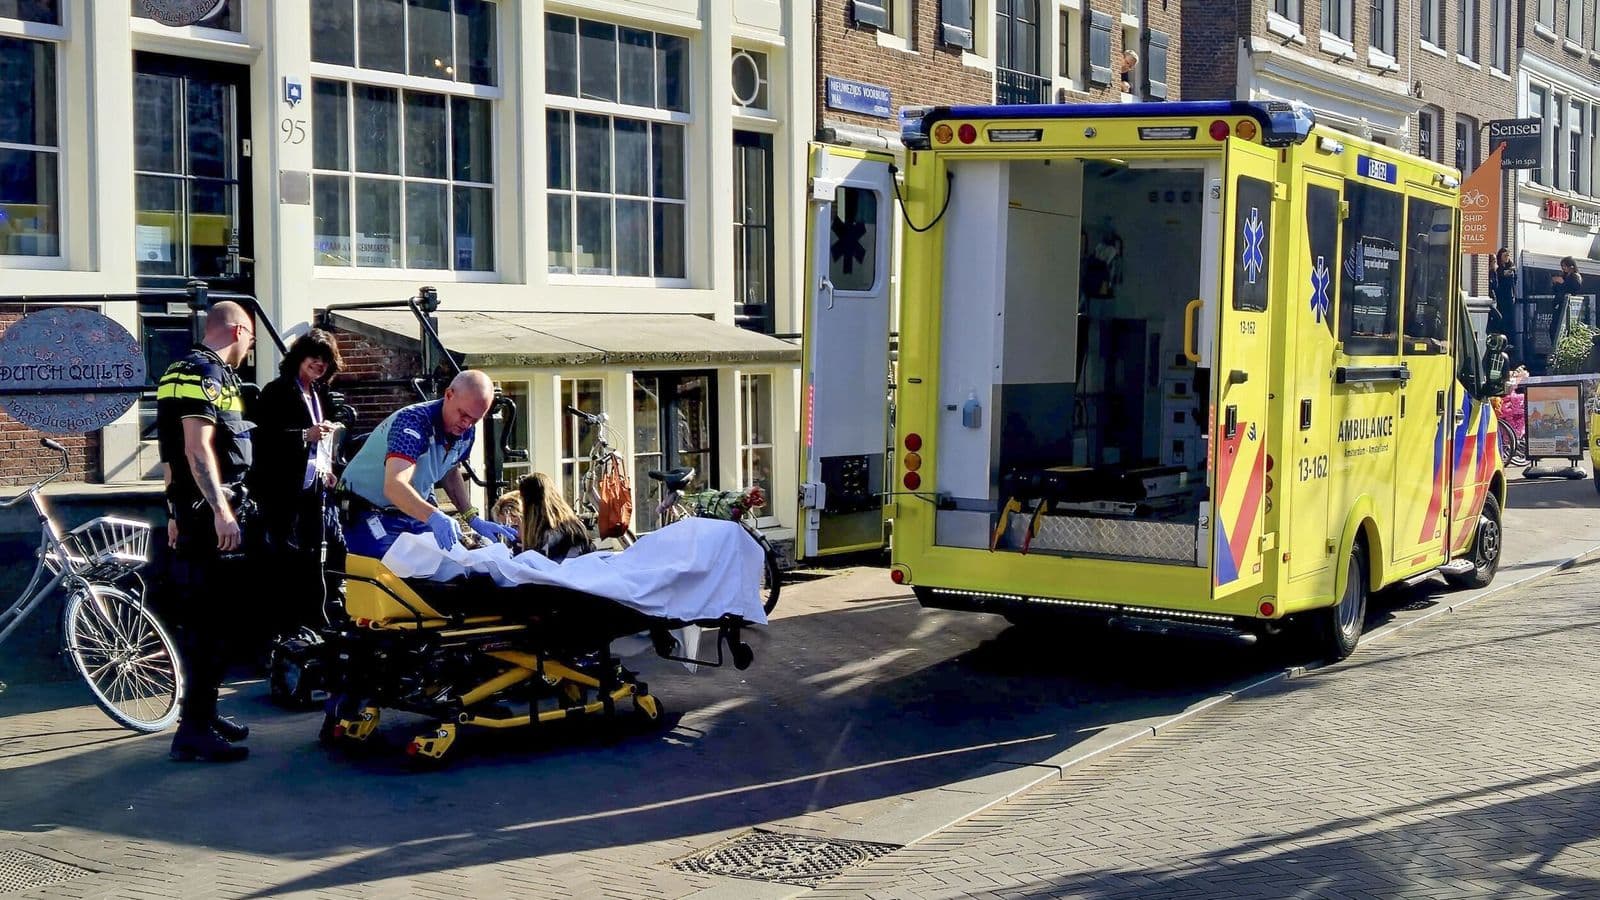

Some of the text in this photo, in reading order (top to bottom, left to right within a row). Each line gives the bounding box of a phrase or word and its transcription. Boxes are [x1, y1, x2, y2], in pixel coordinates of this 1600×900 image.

[281, 118, 306, 144] 95
[1491, 122, 1530, 136] Sense
[1369, 160, 1386, 179] 13-162
[1524, 158, 1536, 167] spa
[1240, 320, 1256, 335] 13-162
[0, 363, 134, 381] DUTCH QUILTS
[7, 399, 92, 430] reproduction
[1337, 415, 1393, 442] AMBULANCE
[1298, 455, 1328, 482] 13-162
